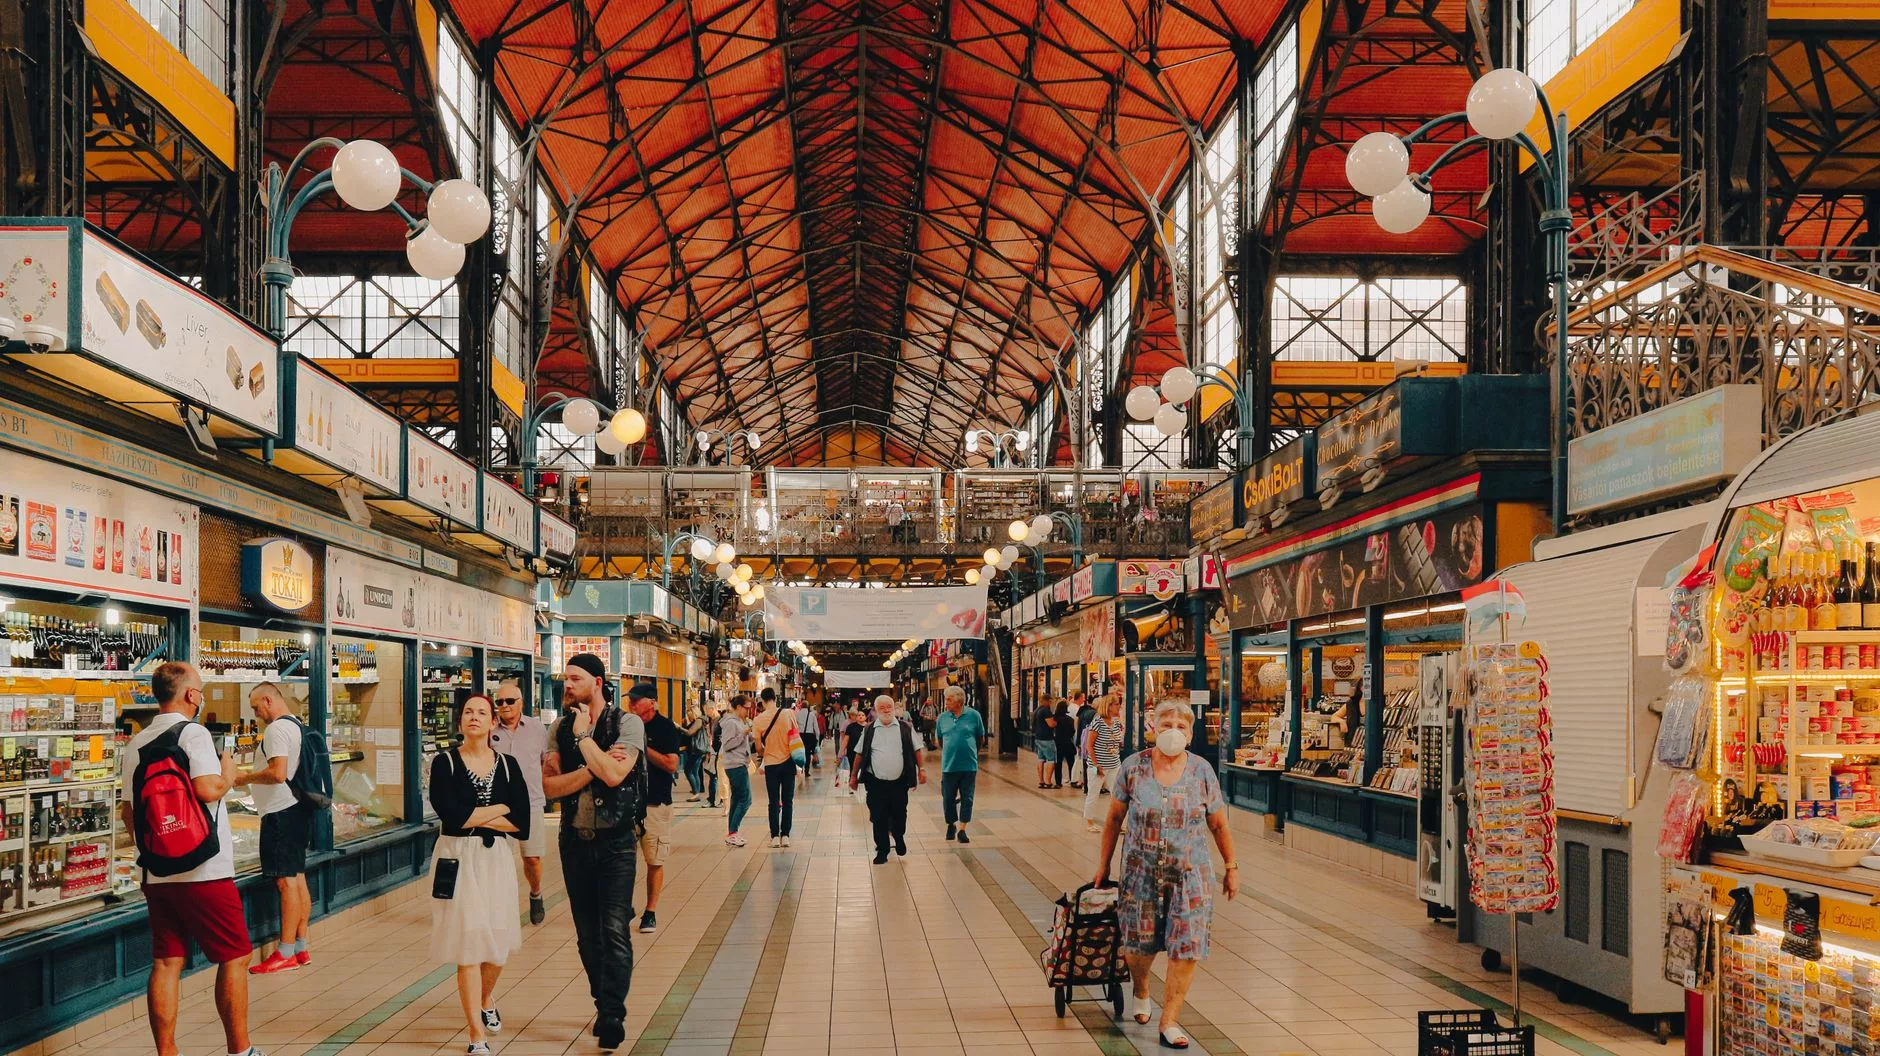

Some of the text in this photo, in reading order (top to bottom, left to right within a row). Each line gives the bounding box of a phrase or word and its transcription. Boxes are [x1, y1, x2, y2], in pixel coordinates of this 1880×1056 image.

[185, 313, 209, 339] Liver
[1317, 434, 1355, 466] Chocolate
[1608, 464, 1655, 497] panaszok
[807, 595, 820, 610] P
